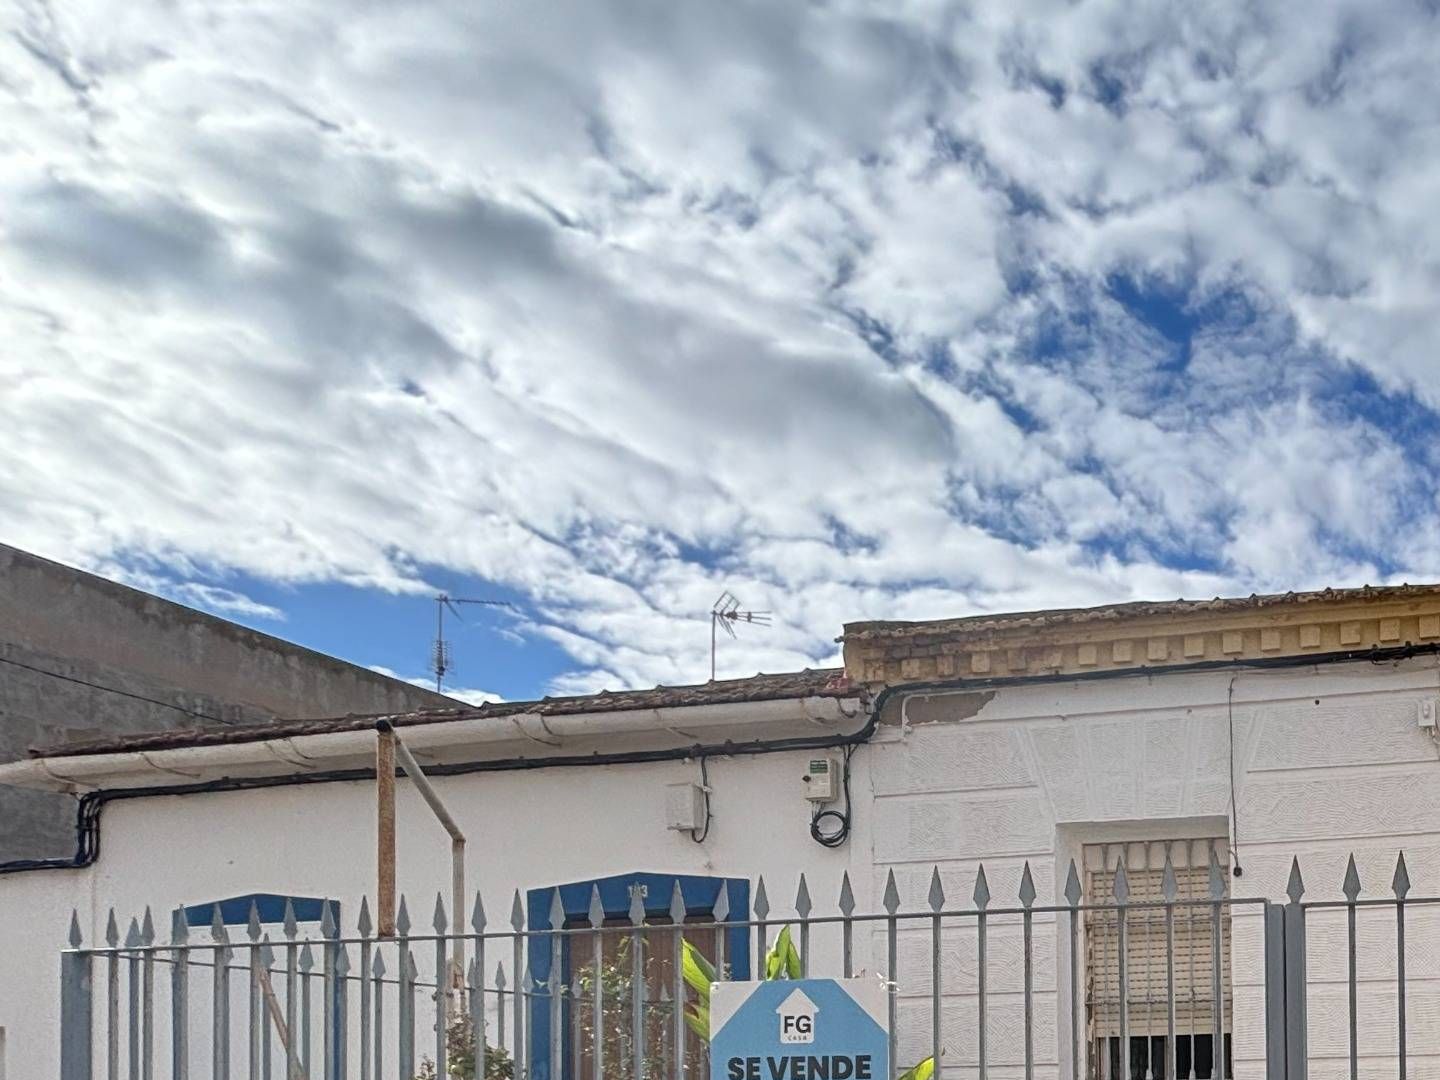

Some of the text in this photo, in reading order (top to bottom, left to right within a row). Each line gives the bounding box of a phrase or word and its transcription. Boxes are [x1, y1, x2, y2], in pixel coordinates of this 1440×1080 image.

[627, 884, 648, 898] 13
[784, 1015, 811, 1034] FG
[767, 1055, 872, 1080] VENDE
